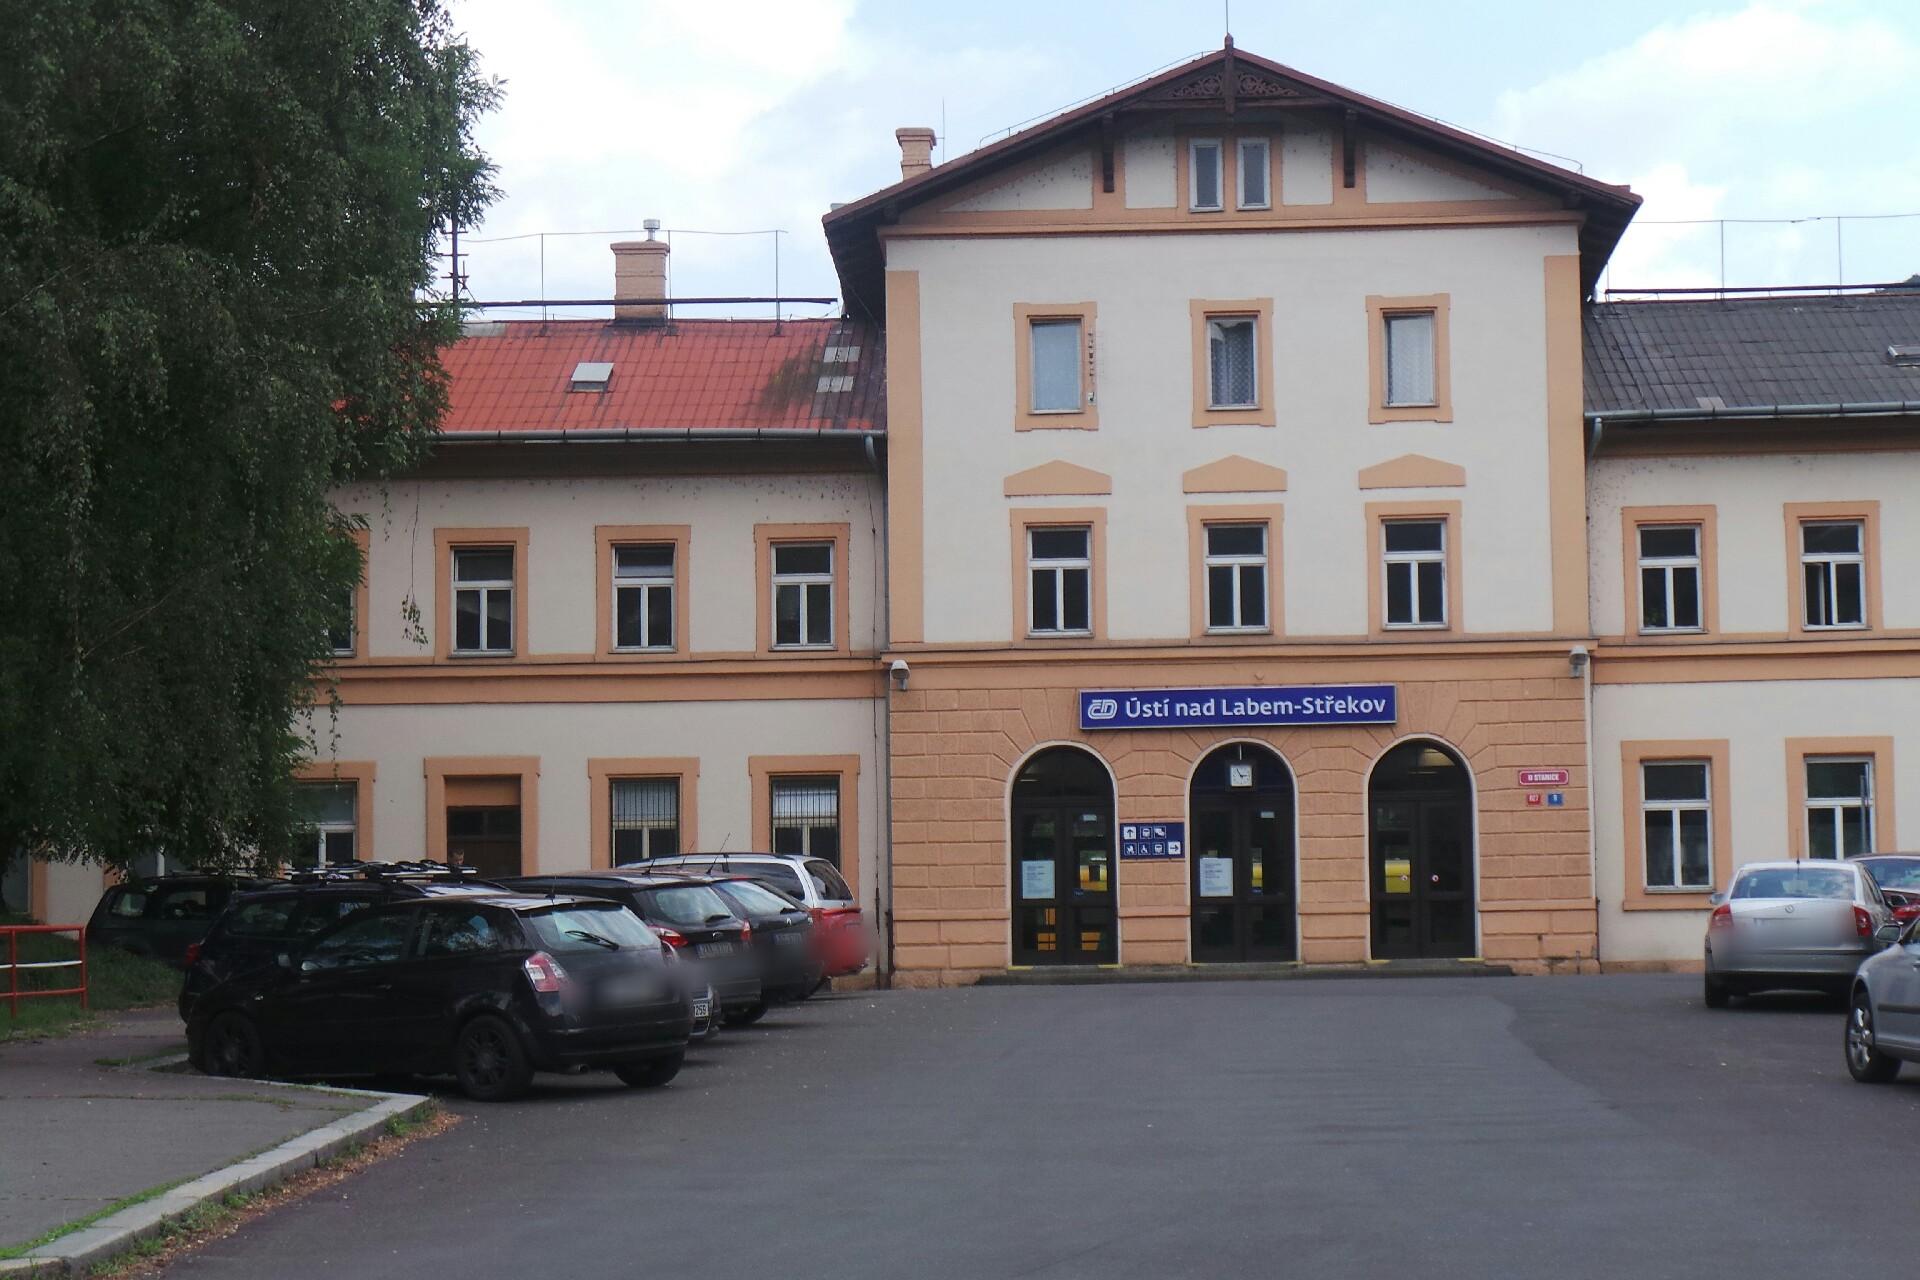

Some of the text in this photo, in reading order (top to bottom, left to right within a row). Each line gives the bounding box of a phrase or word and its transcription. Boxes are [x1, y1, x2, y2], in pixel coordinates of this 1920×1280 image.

[1126, 697, 1170, 718] Ústí
[1176, 698, 1215, 716] nad
[1222, 696, 1386, 716] Labem-Střekov
